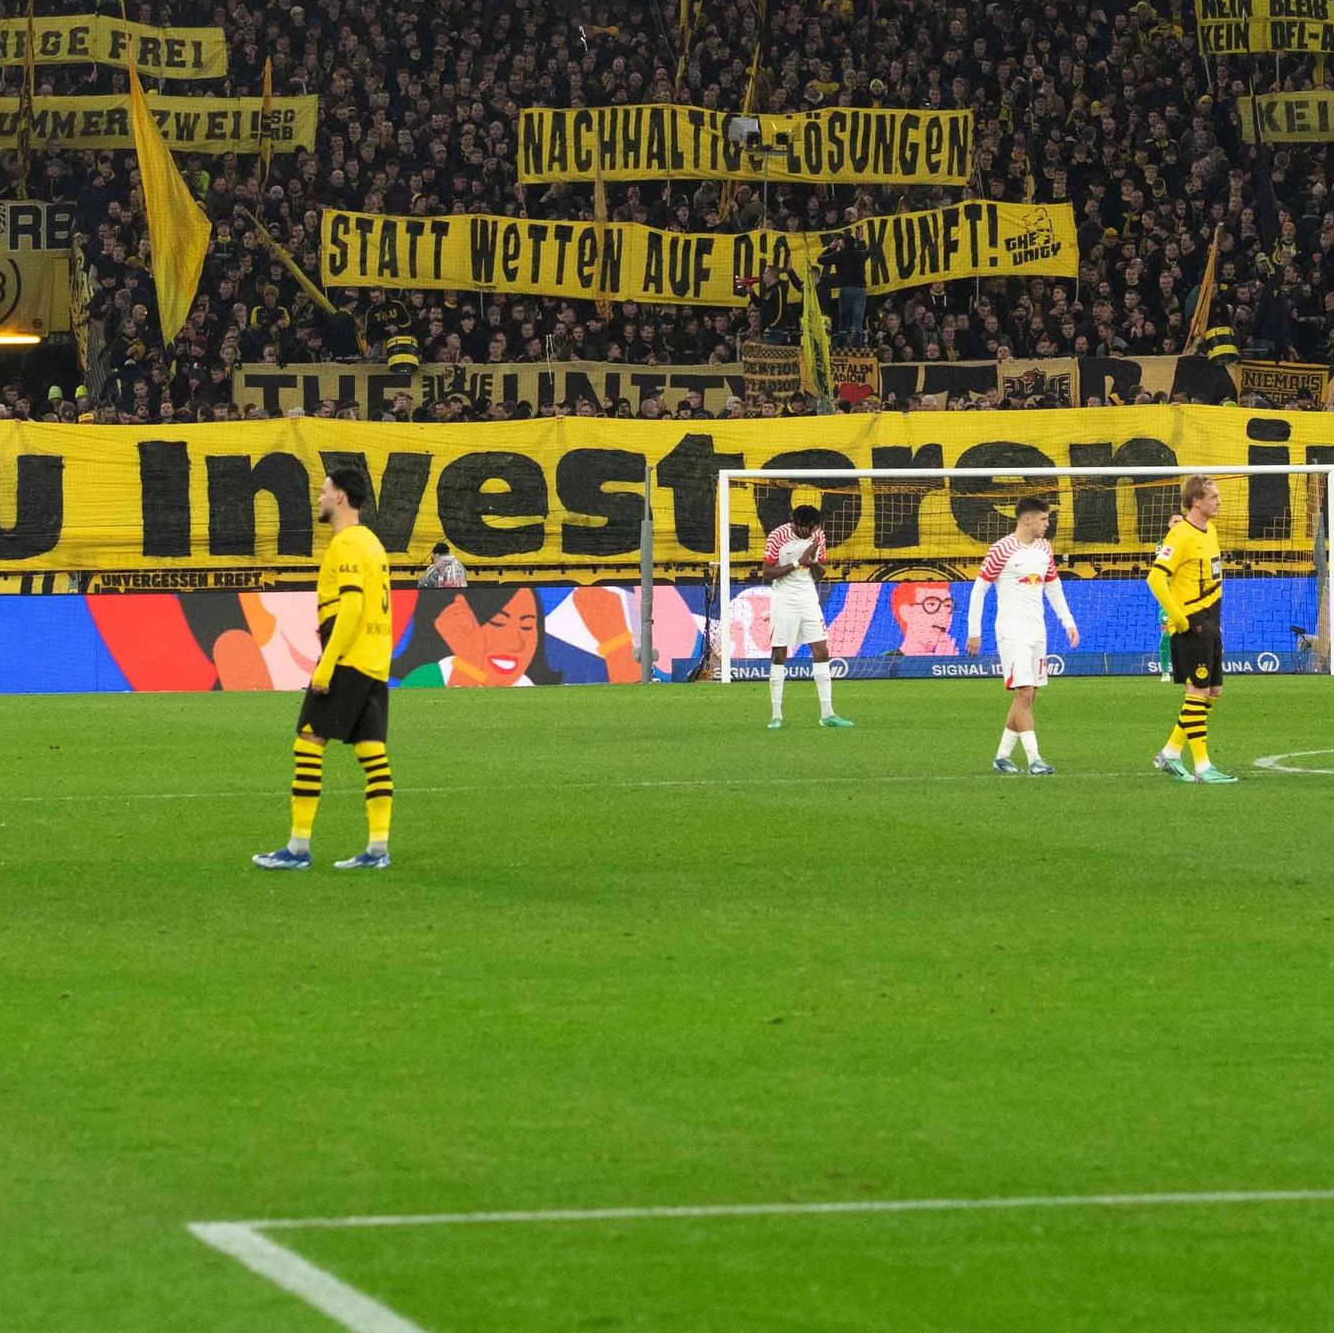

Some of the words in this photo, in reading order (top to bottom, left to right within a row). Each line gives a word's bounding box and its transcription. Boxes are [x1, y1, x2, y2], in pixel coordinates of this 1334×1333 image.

[109, 29, 203, 68] FREI
[1199, 22, 1250, 52] KEIN
[523, 106, 761, 174] NACHHALTi
[328, 213, 450, 279] STATT
[642, 230, 715, 298] AUF
[827, 362, 873, 375] STFALEN
[1243, 370, 1323, 395] NIEMALS
[137, 432, 1181, 559] Investoren
[101, 572, 209, 588] UNVERGESSEN
[213, 571, 263, 587] KREFT
[713, 666, 766, 679] SGNAL
[779, 665, 818, 678] DUNA
[931, 664, 988, 676] SIGNAL
[1221, 661, 1254, 673] UNA
